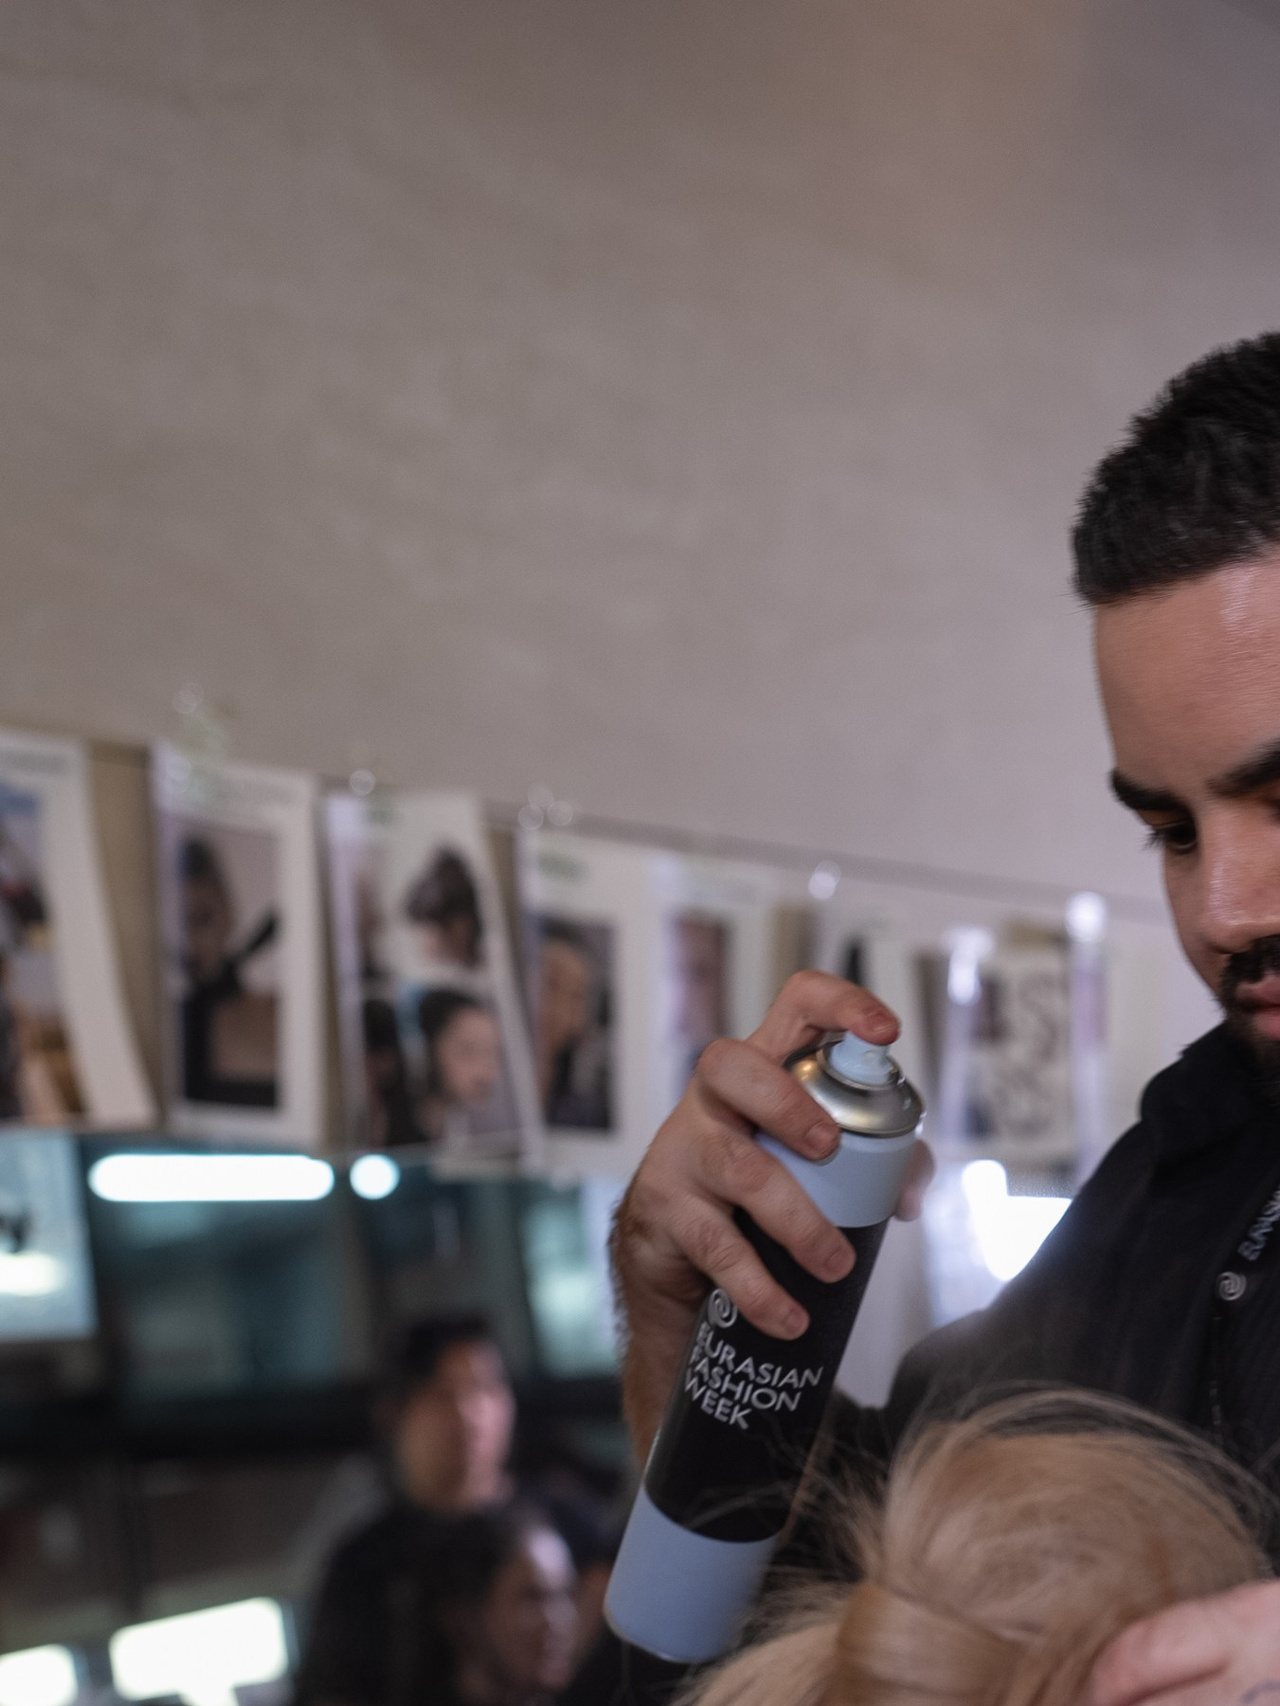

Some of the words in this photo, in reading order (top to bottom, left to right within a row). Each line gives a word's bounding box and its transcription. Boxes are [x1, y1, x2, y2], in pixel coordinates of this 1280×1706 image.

[688, 1344, 803, 1412] FASHION
[696, 1320, 824, 1389] EURASIAN
[683, 1367, 753, 1430] WEEK
